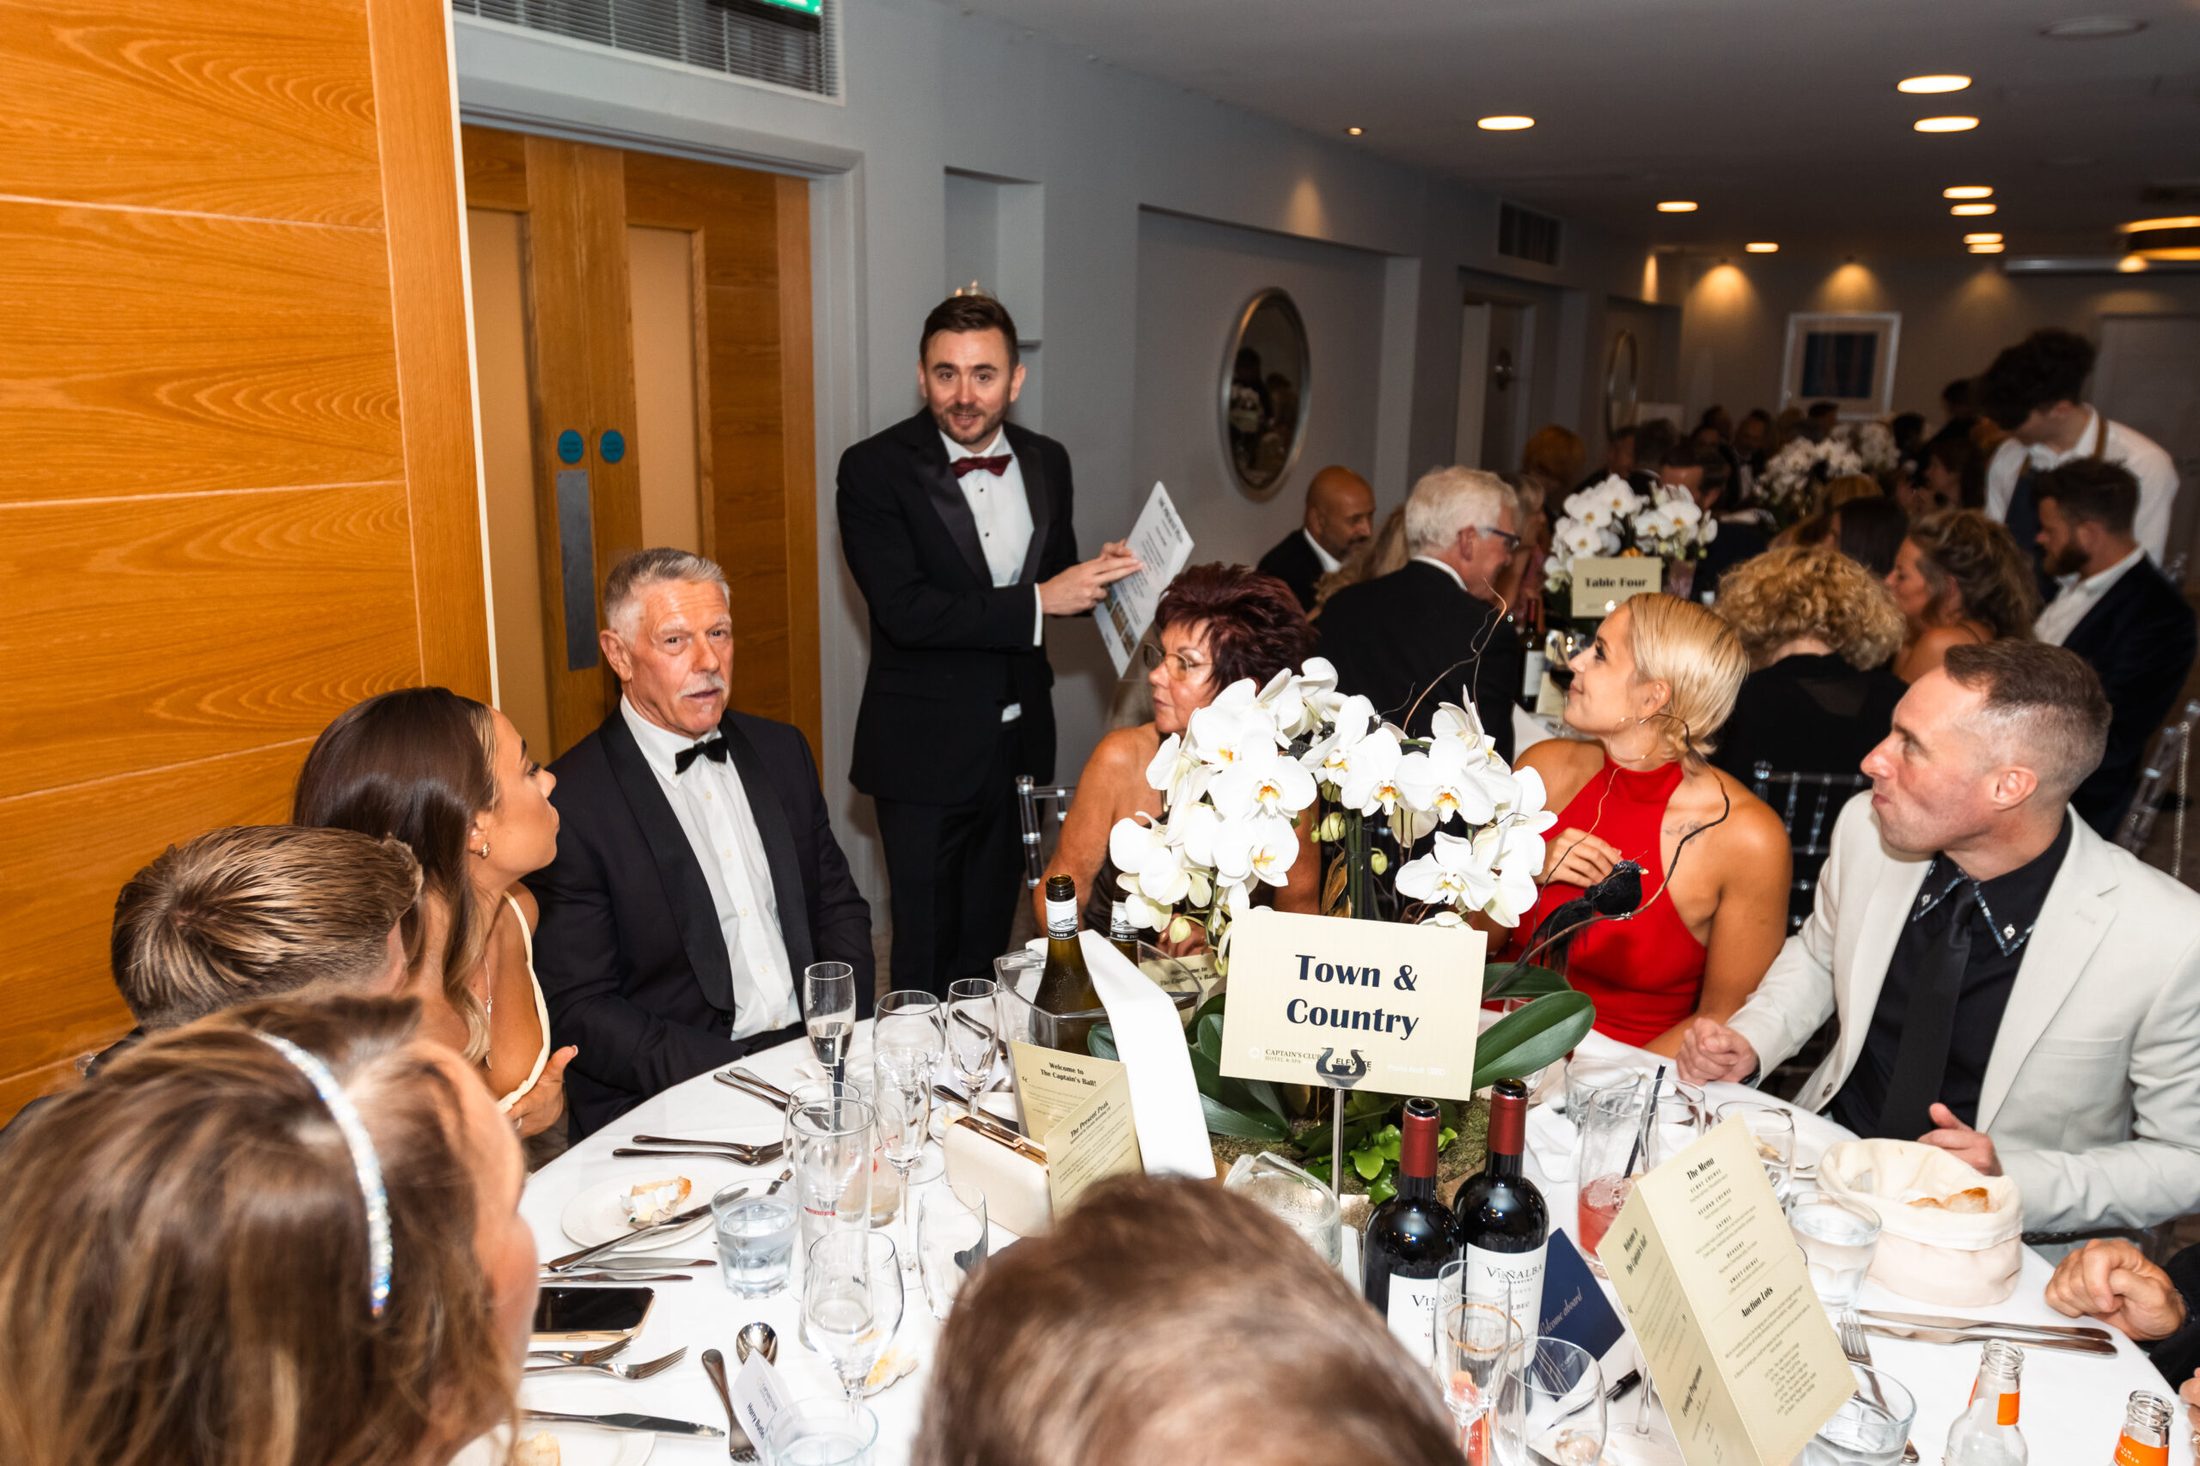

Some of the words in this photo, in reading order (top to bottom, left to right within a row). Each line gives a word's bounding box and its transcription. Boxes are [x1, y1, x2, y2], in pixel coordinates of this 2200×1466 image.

[1585, 577, 1616, 588] Table
[1620, 577, 1648, 588] Four
[1295, 954, 1381, 988] Town
[1393, 964, 1418, 991] &
[1286, 998, 1419, 1041] Country
[1040, 1069, 1051, 1077] The
[1052, 1072, 1081, 1084] Captain's
[1049, 1062, 1077, 1074] Welcome
[1070, 1127, 1079, 1138] The
[1080, 1110, 1098, 1130] Present
[1097, 1100, 1109, 1114] Peak
[1686, 1168, 1699, 1181] The
[1697, 1157, 1715, 1172] Menu
[1741, 1296, 1762, 1317] Auction
[1760, 1286, 1774, 1301] Lots
